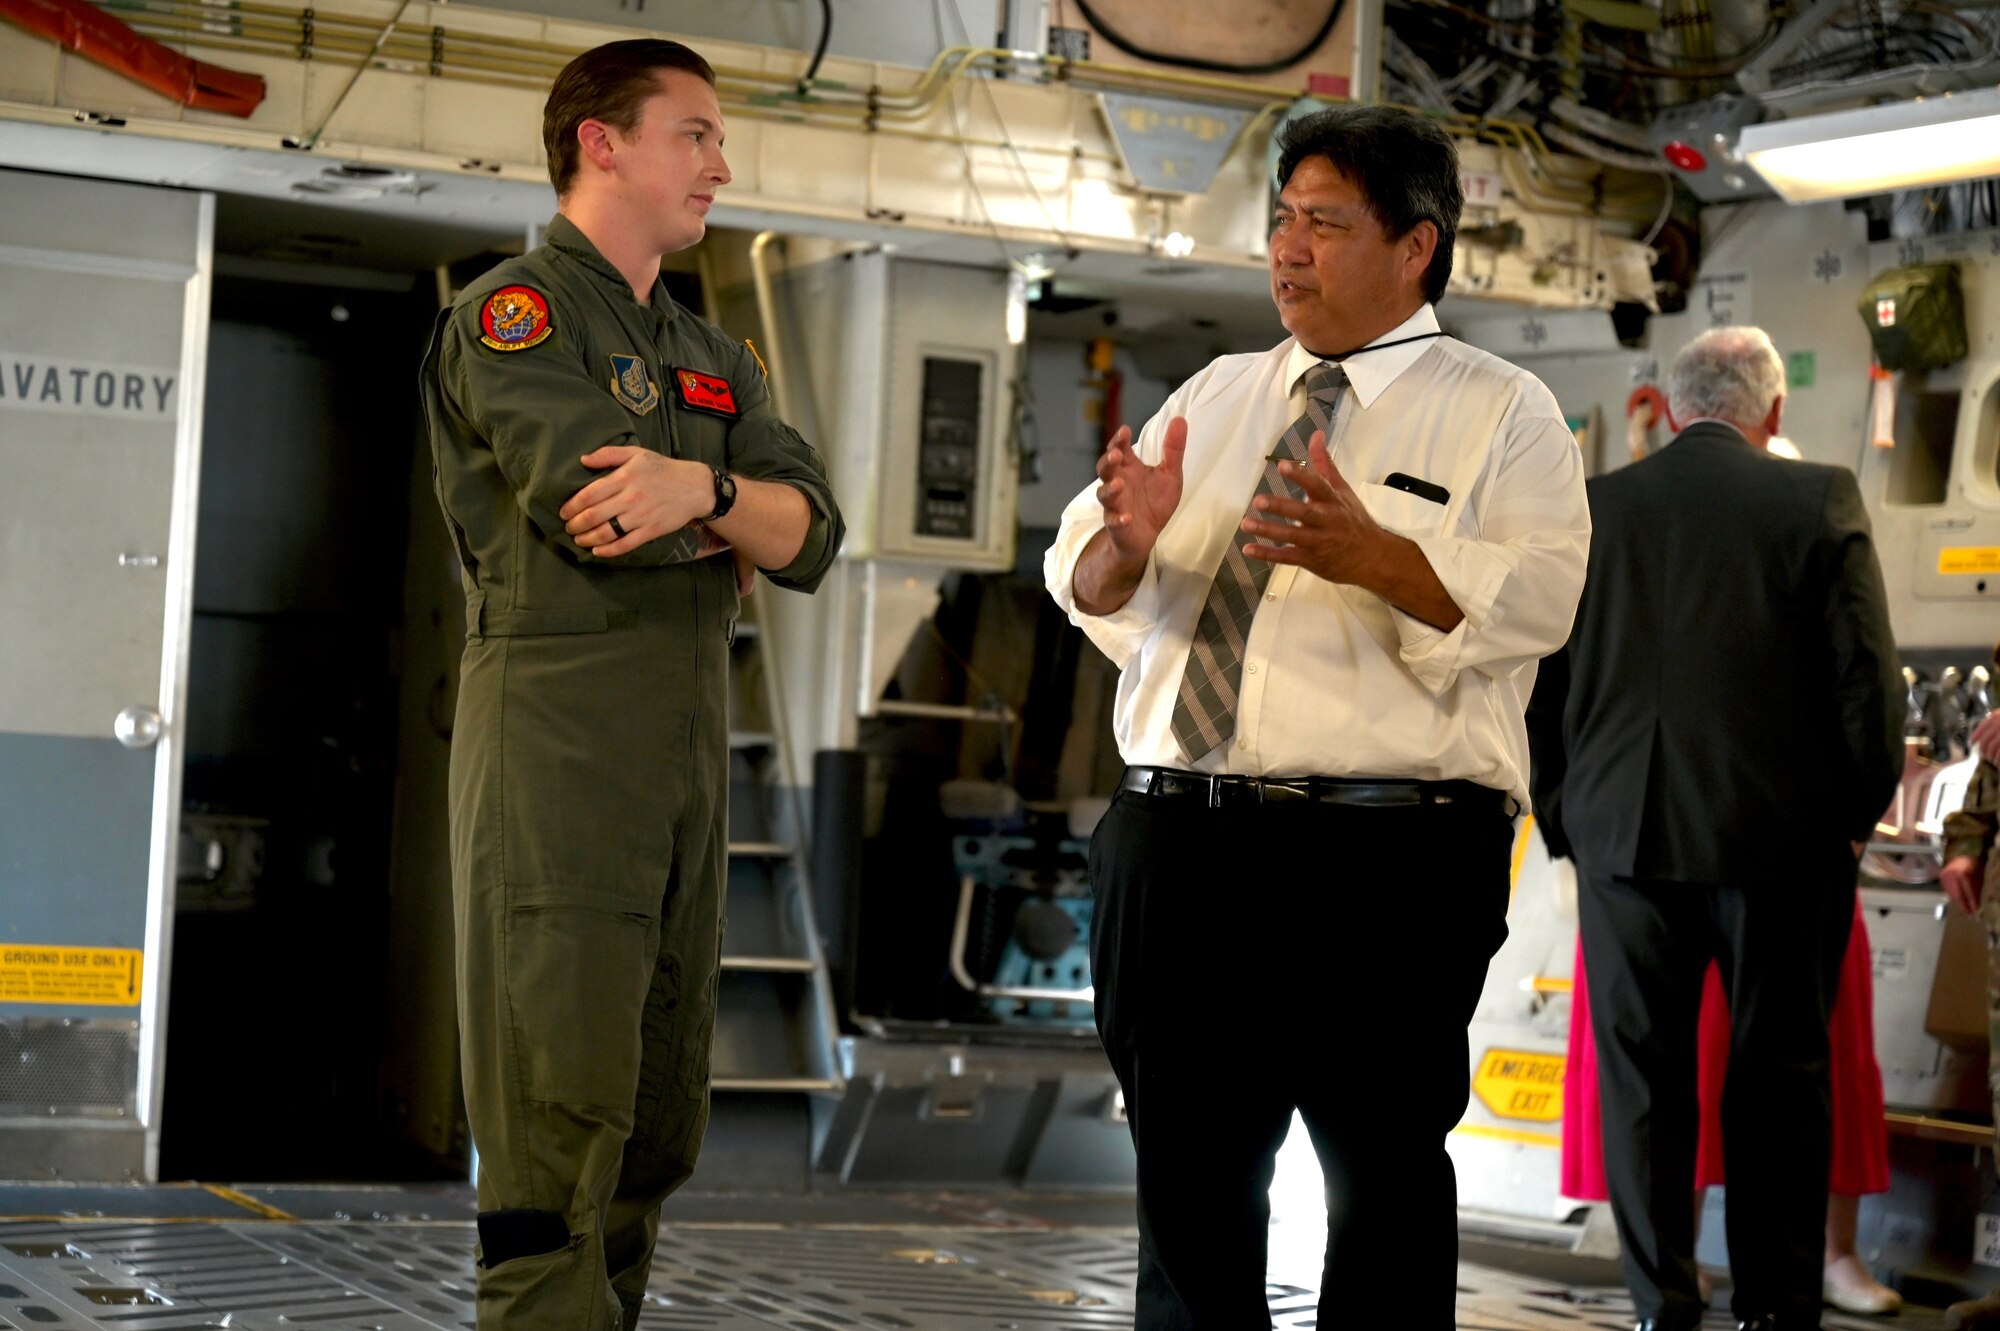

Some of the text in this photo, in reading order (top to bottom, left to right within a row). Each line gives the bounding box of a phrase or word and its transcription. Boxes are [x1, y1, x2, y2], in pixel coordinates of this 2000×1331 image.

[0, 362, 174, 413] VATORY
[4, 949, 127, 968] GROUND USE ONLY
[1487, 1058, 1566, 1085] EMERGE
[1508, 1089, 1553, 1113] EXIT
